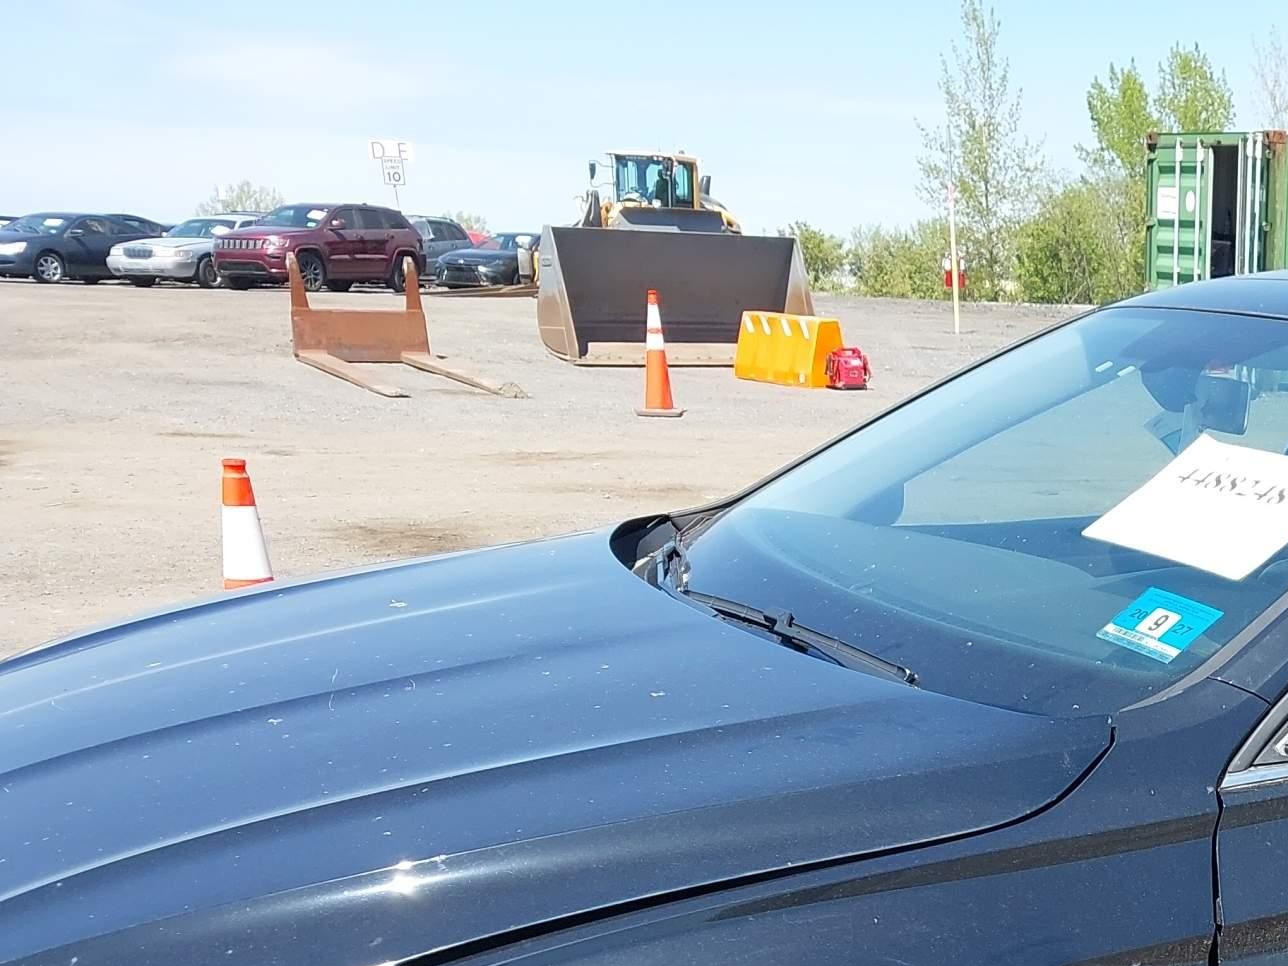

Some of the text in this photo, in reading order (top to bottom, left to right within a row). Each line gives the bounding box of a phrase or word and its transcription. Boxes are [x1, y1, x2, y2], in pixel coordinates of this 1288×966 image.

[387, 171, 401, 182] 10
[1148, 614, 1169, 632] 9
[1172, 623, 1193, 636] 27
